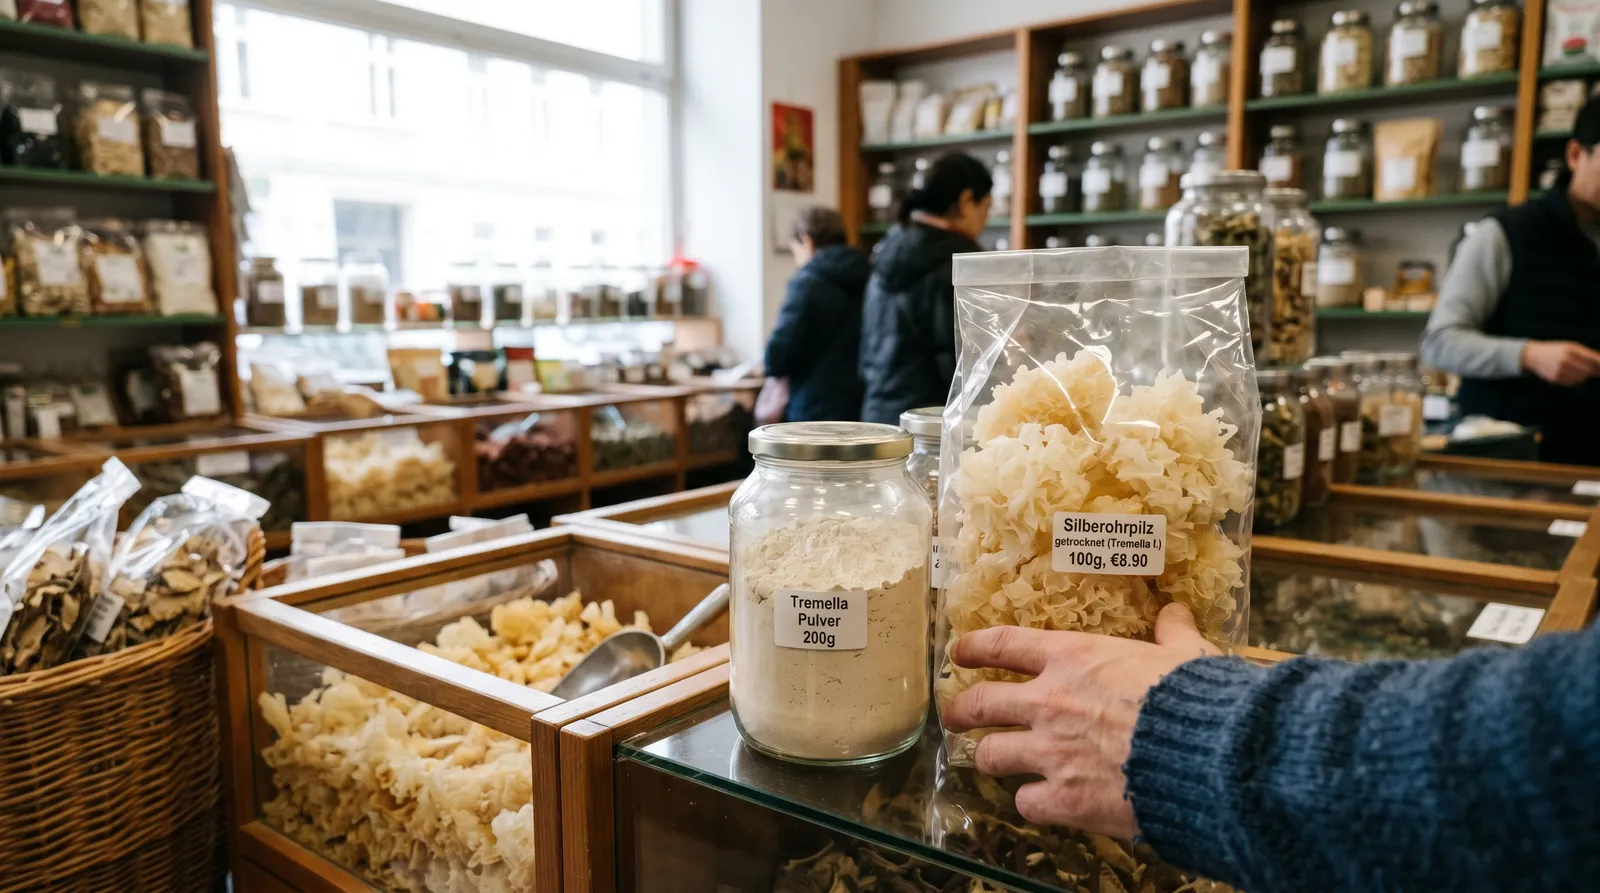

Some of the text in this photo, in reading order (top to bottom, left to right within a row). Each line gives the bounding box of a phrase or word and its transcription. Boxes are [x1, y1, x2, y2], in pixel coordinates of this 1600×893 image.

[1063, 518, 1154, 537] Silberohrpilz
[1054, 537, 1105, 548] getrocknet
[1107, 538, 1151, 549] (Tremella
[1069, 551, 1148, 569] 100g, €8.90
[790, 595, 848, 610] Tremella
[798, 612, 841, 627] Pulver
[803, 630, 835, 648] 200g
